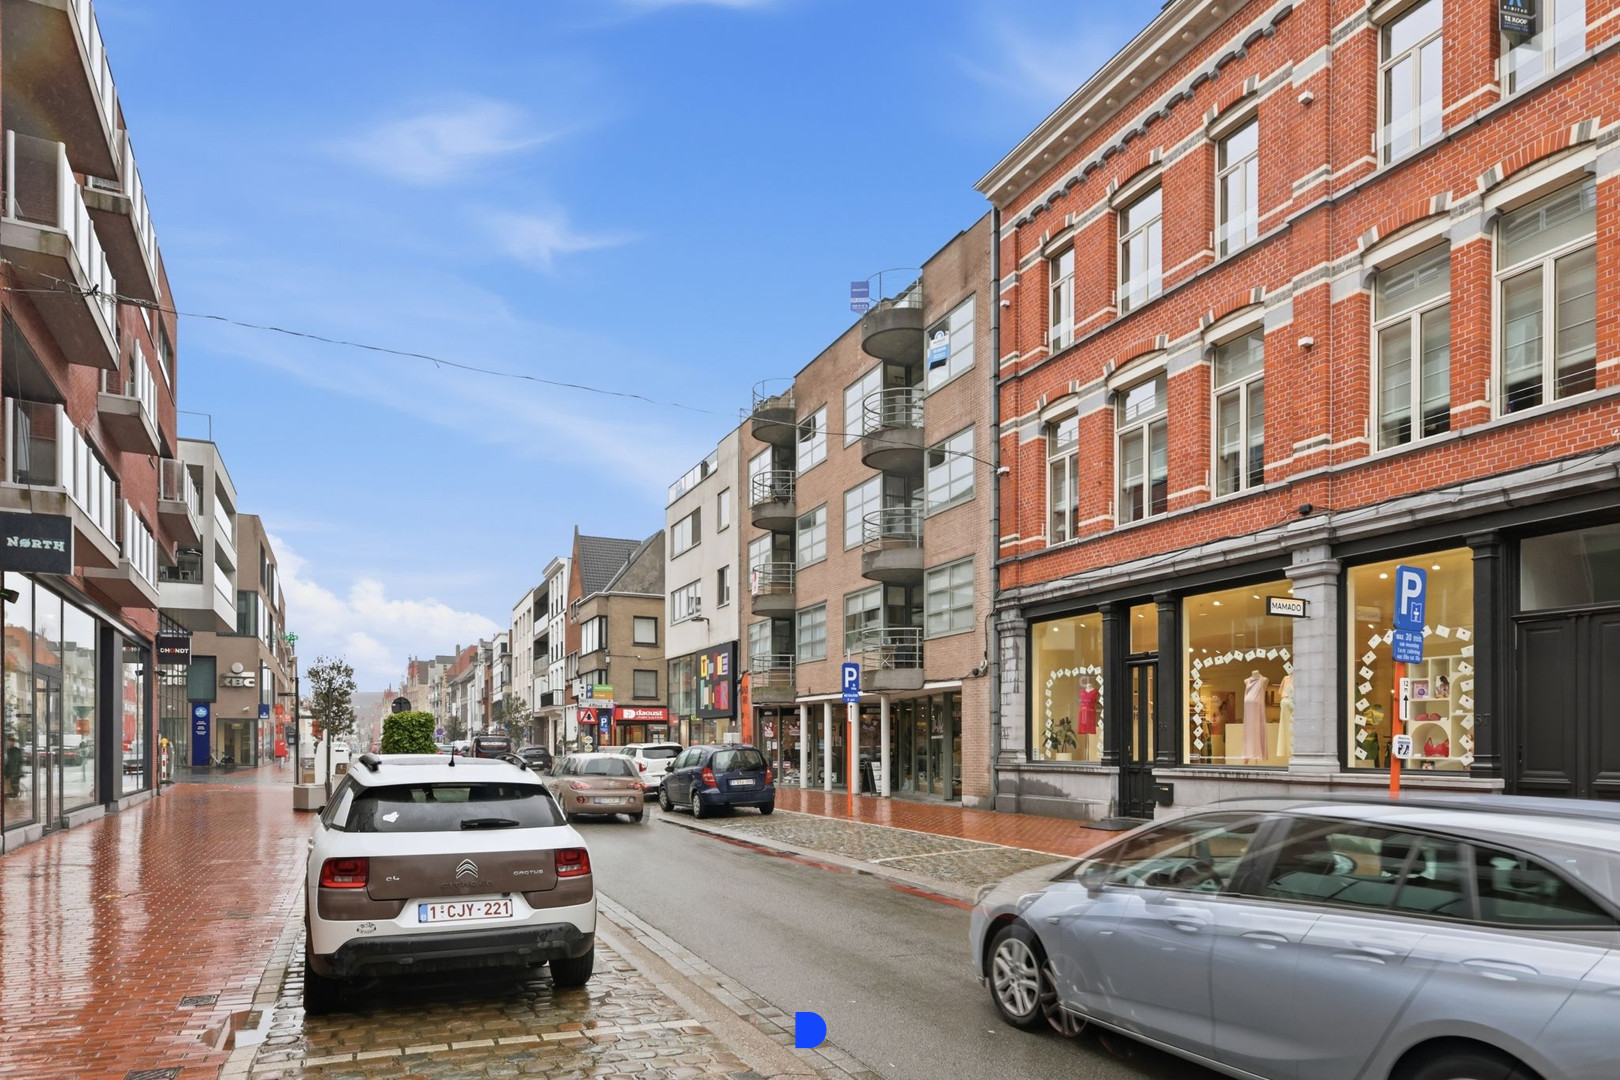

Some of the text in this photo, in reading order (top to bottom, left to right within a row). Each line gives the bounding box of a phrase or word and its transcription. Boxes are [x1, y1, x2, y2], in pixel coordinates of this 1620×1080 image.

[1401, 570, 1422, 615] P
[1272, 602, 1302, 612] MAMADO
[1405, 632, 1412, 642] 30
[219, 678, 255, 687] KBC
[844, 667, 857, 688] P
[600, 717, 608, 727] P
